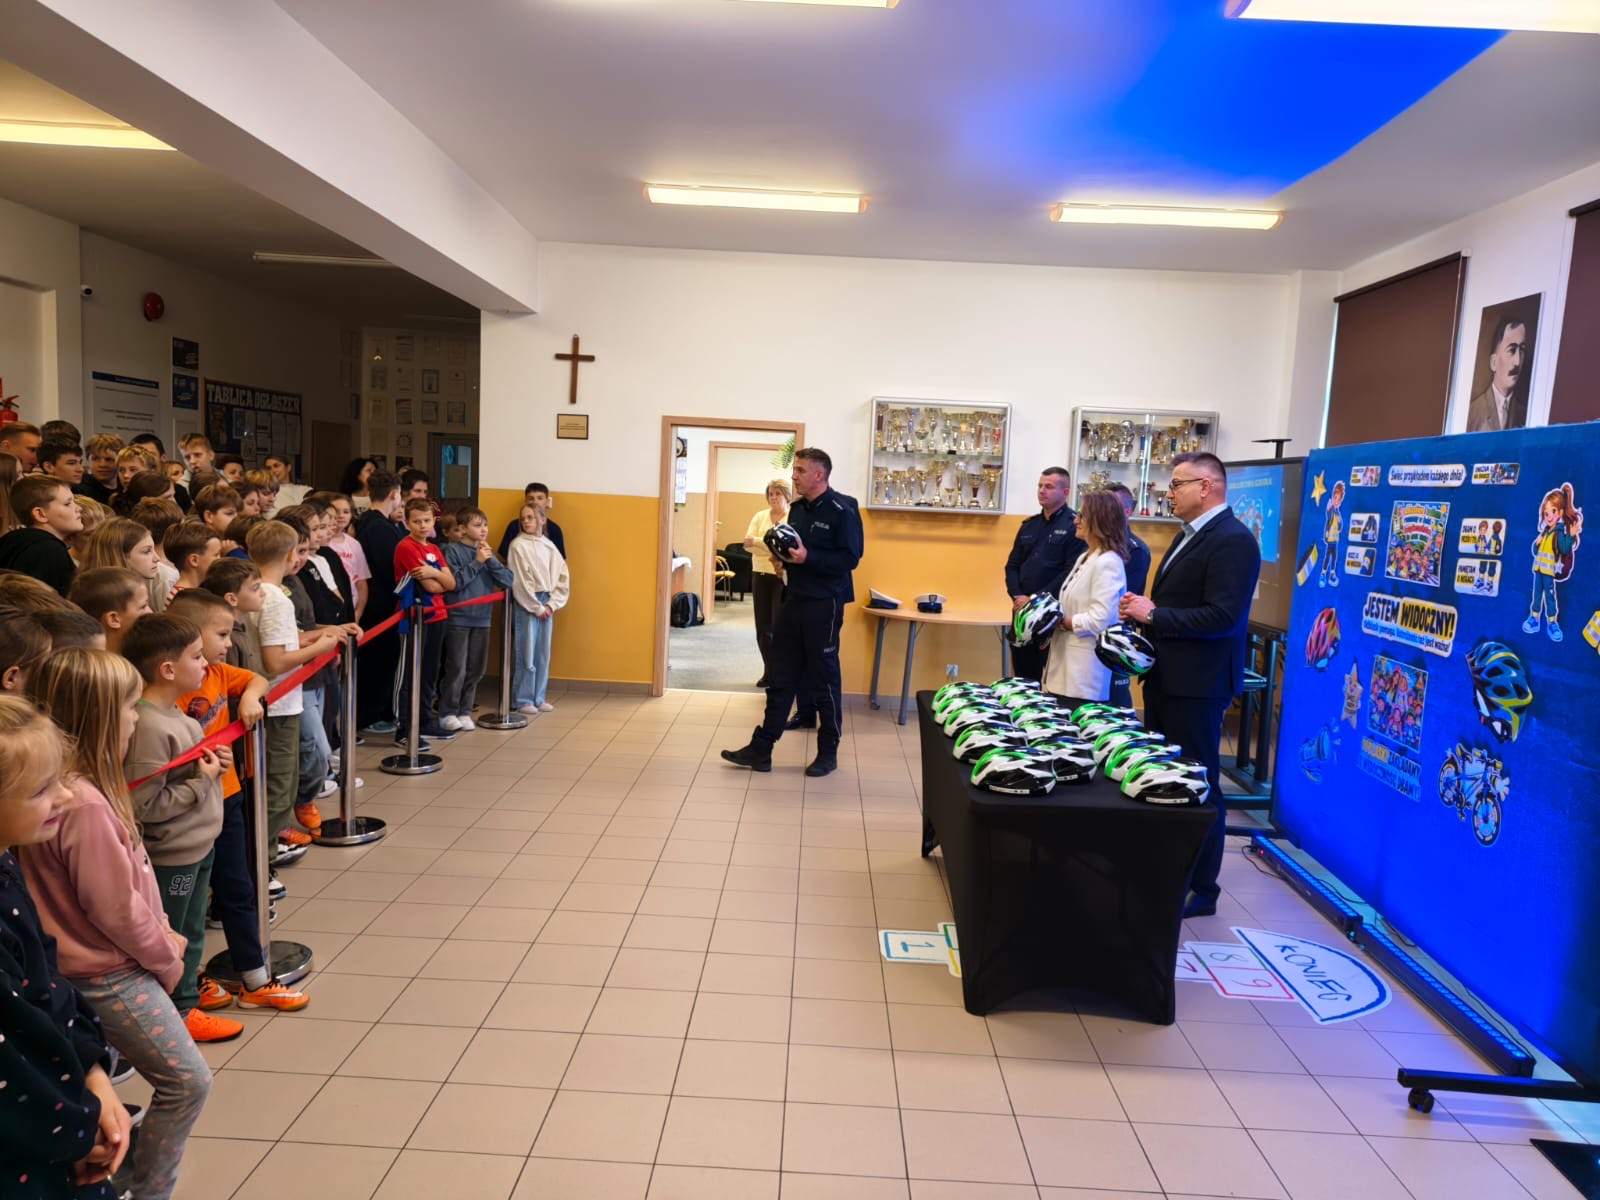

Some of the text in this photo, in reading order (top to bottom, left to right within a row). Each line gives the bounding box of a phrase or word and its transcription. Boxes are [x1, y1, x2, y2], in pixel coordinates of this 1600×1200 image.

[206, 383, 253, 408] TABLICA
[1364, 596, 1400, 625] JESTEM
[1400, 602, 1456, 639] WIDOCZNY!
[169, 873, 193, 892] 92
[1274, 944, 1353, 1002] KONIEC
